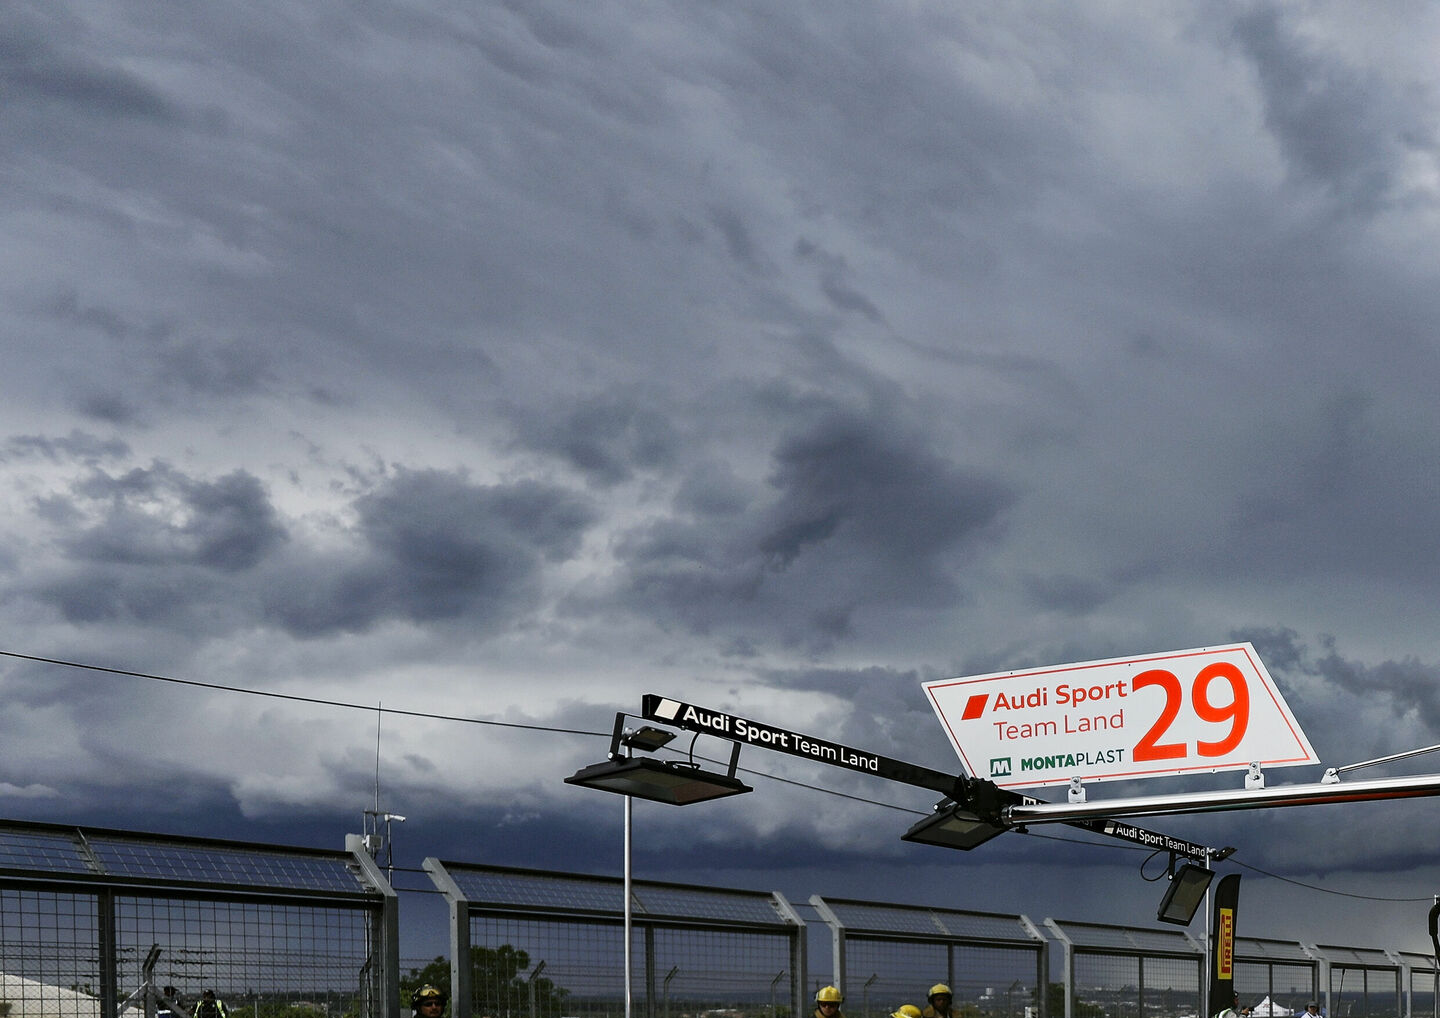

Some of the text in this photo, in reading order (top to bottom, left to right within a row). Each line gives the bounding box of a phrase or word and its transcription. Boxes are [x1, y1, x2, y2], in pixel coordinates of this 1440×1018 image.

[992, 680, 1128, 712] Audi Sport
[1132, 662, 1250, 762] 29
[682, 705, 878, 771] Audi Sport Team Land
[993, 709, 1125, 741] Team Land
[1021, 749, 1125, 771] MONTAPLAST
[1116, 825, 1137, 839] Audi
[1139, 830, 1164, 846] Sport
[1164, 836, 1186, 852] Team
[1221, 914, 1232, 974] PIRELLI
